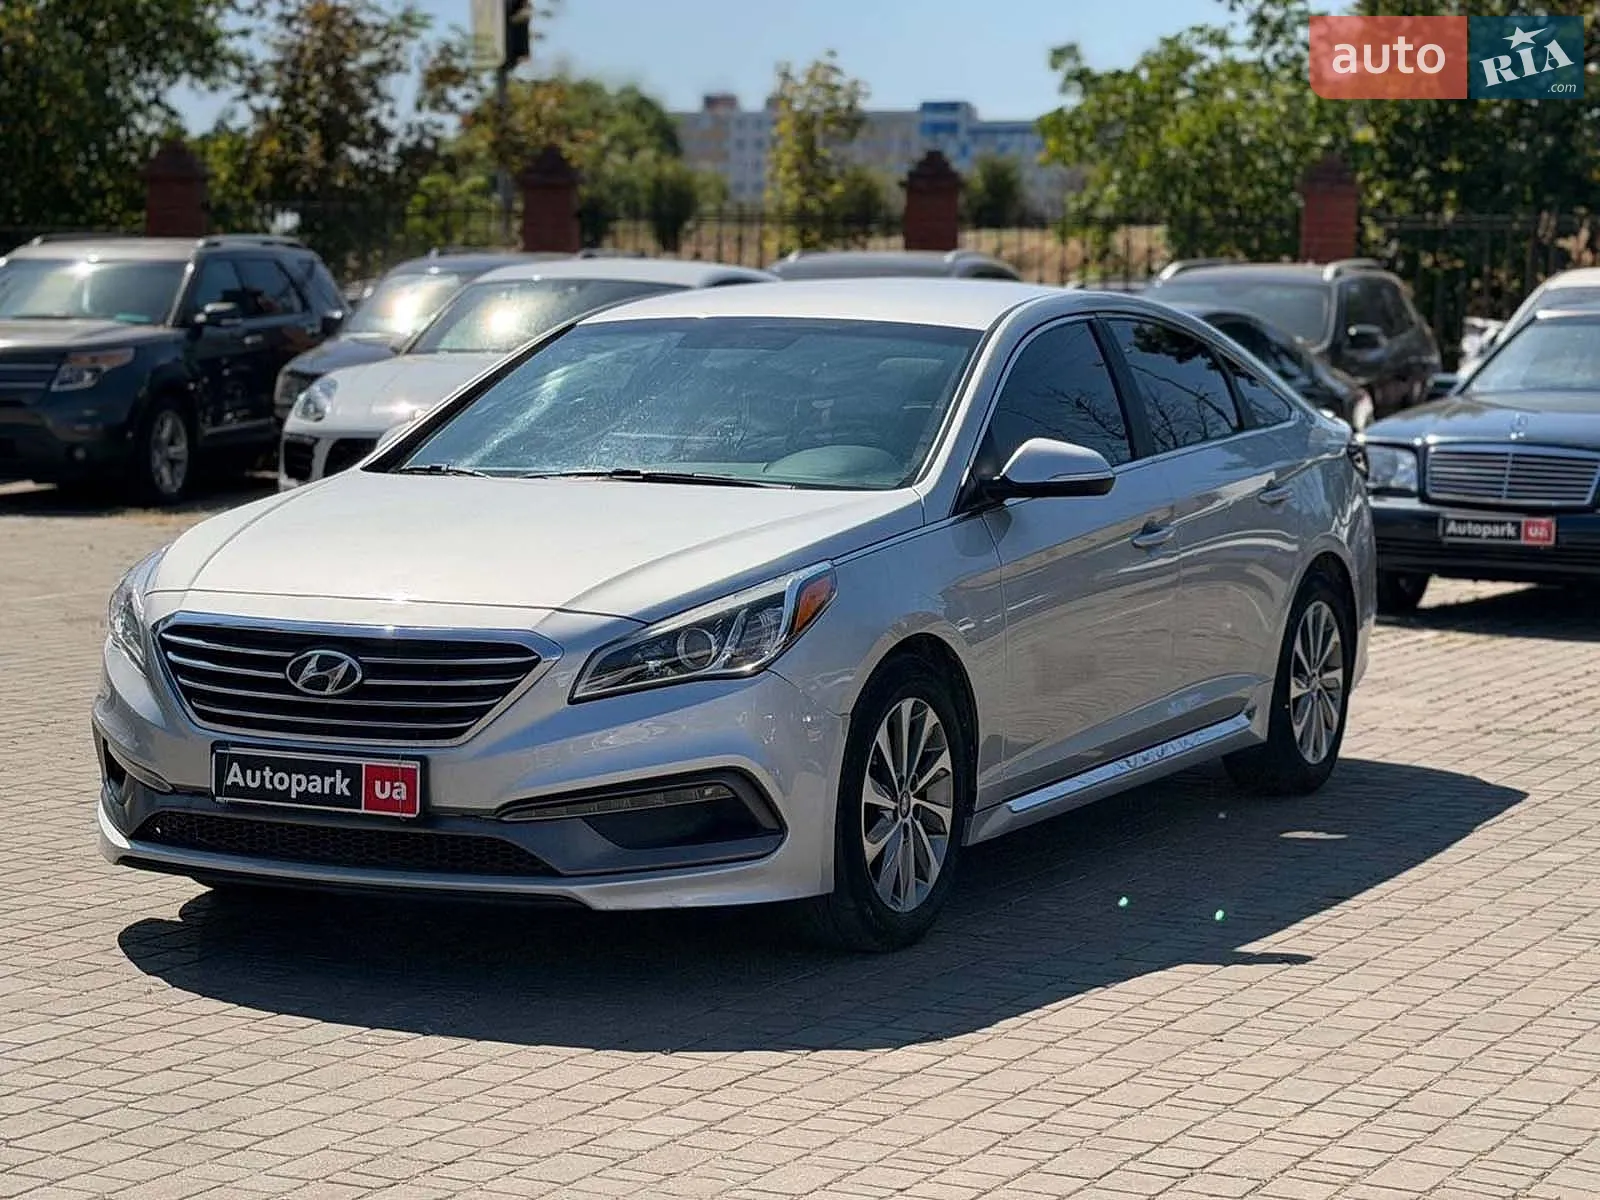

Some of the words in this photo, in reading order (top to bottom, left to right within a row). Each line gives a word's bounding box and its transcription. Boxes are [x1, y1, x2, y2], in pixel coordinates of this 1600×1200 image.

[1446, 520, 1517, 539] Autopark
[1528, 526, 1548, 538] ua
[226, 762, 351, 798] Autopark
[375, 780, 407, 800] ua
